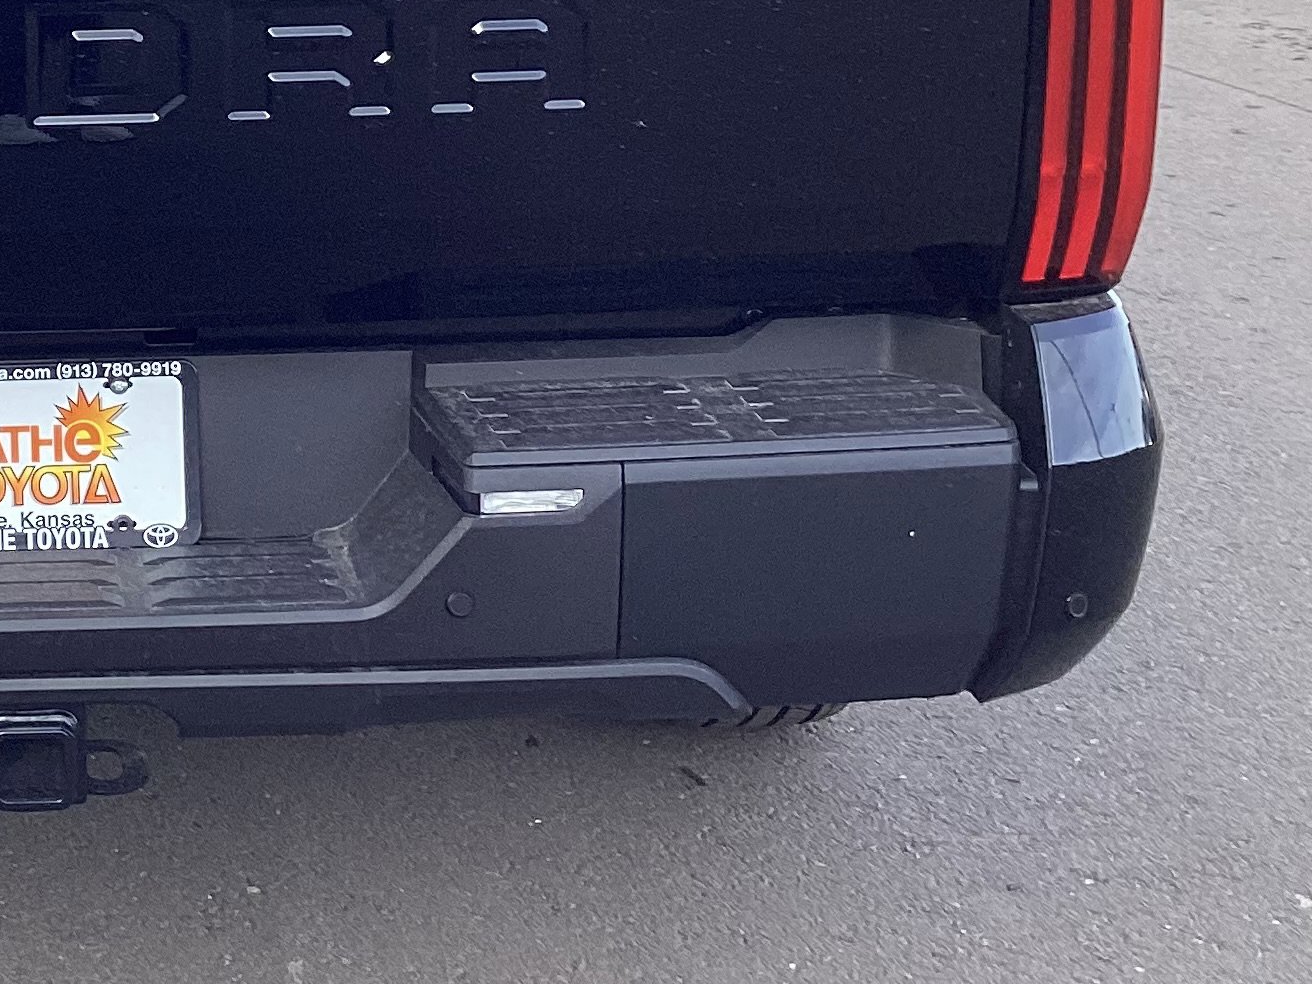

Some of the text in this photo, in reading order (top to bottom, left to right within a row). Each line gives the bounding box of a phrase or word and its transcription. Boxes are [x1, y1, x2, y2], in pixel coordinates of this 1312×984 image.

[56, 362, 98, 379] (913)
[102, 361, 182, 377] 780-9919
[20, 511, 95, 528] Kansas
[22, 526, 109, 550] TOYOTA
